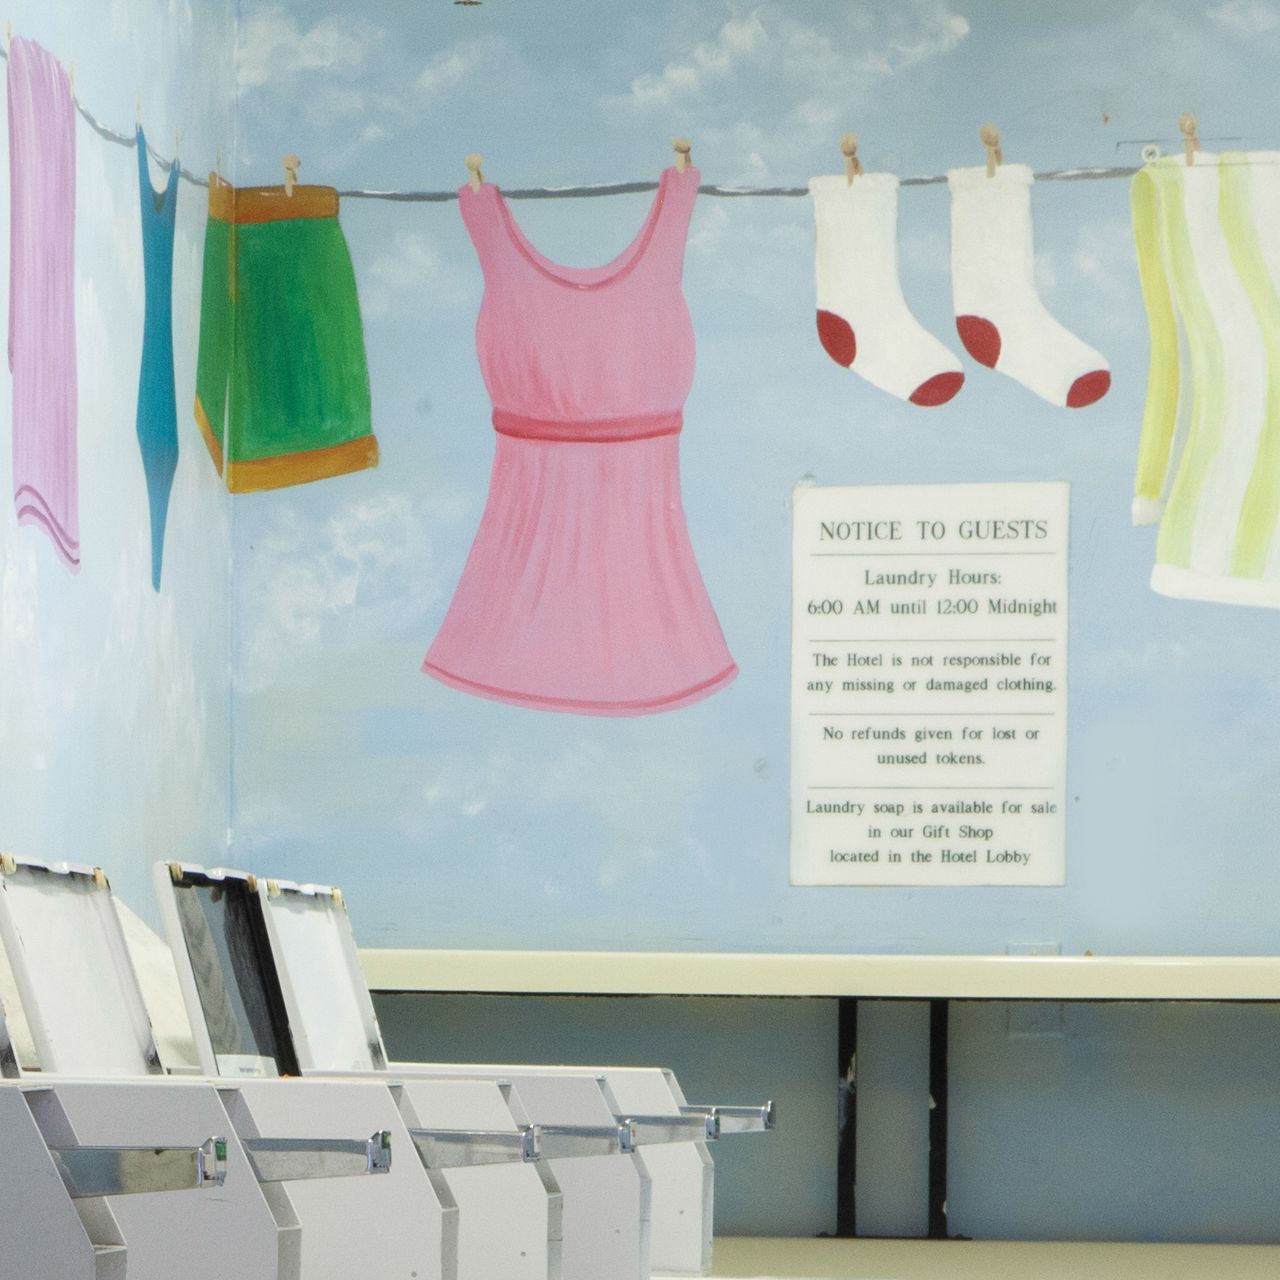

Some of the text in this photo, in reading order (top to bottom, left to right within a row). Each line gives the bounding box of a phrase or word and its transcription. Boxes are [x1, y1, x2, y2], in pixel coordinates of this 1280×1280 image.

[819, 520, 1048, 541] NOTICE TO GUESTS
[864, 570, 1002, 587] Laundry Hours:
[807, 600, 1058, 616] 6:00 AM until 12:00 Midnight
[813, 652, 1051, 668] The Hotel is not responsible for
[807, 677, 1057, 693] any missing or damaged clothing.
[823, 727, 1040, 742] No refunds given for lost or
[877, 751, 985, 765] unused tokens.
[806, 800, 1057, 816] Laundry soap is available for sale
[868, 825, 993, 840] in our Gift Shop
[829, 850, 1031, 865] located in the Hotel Lobby
